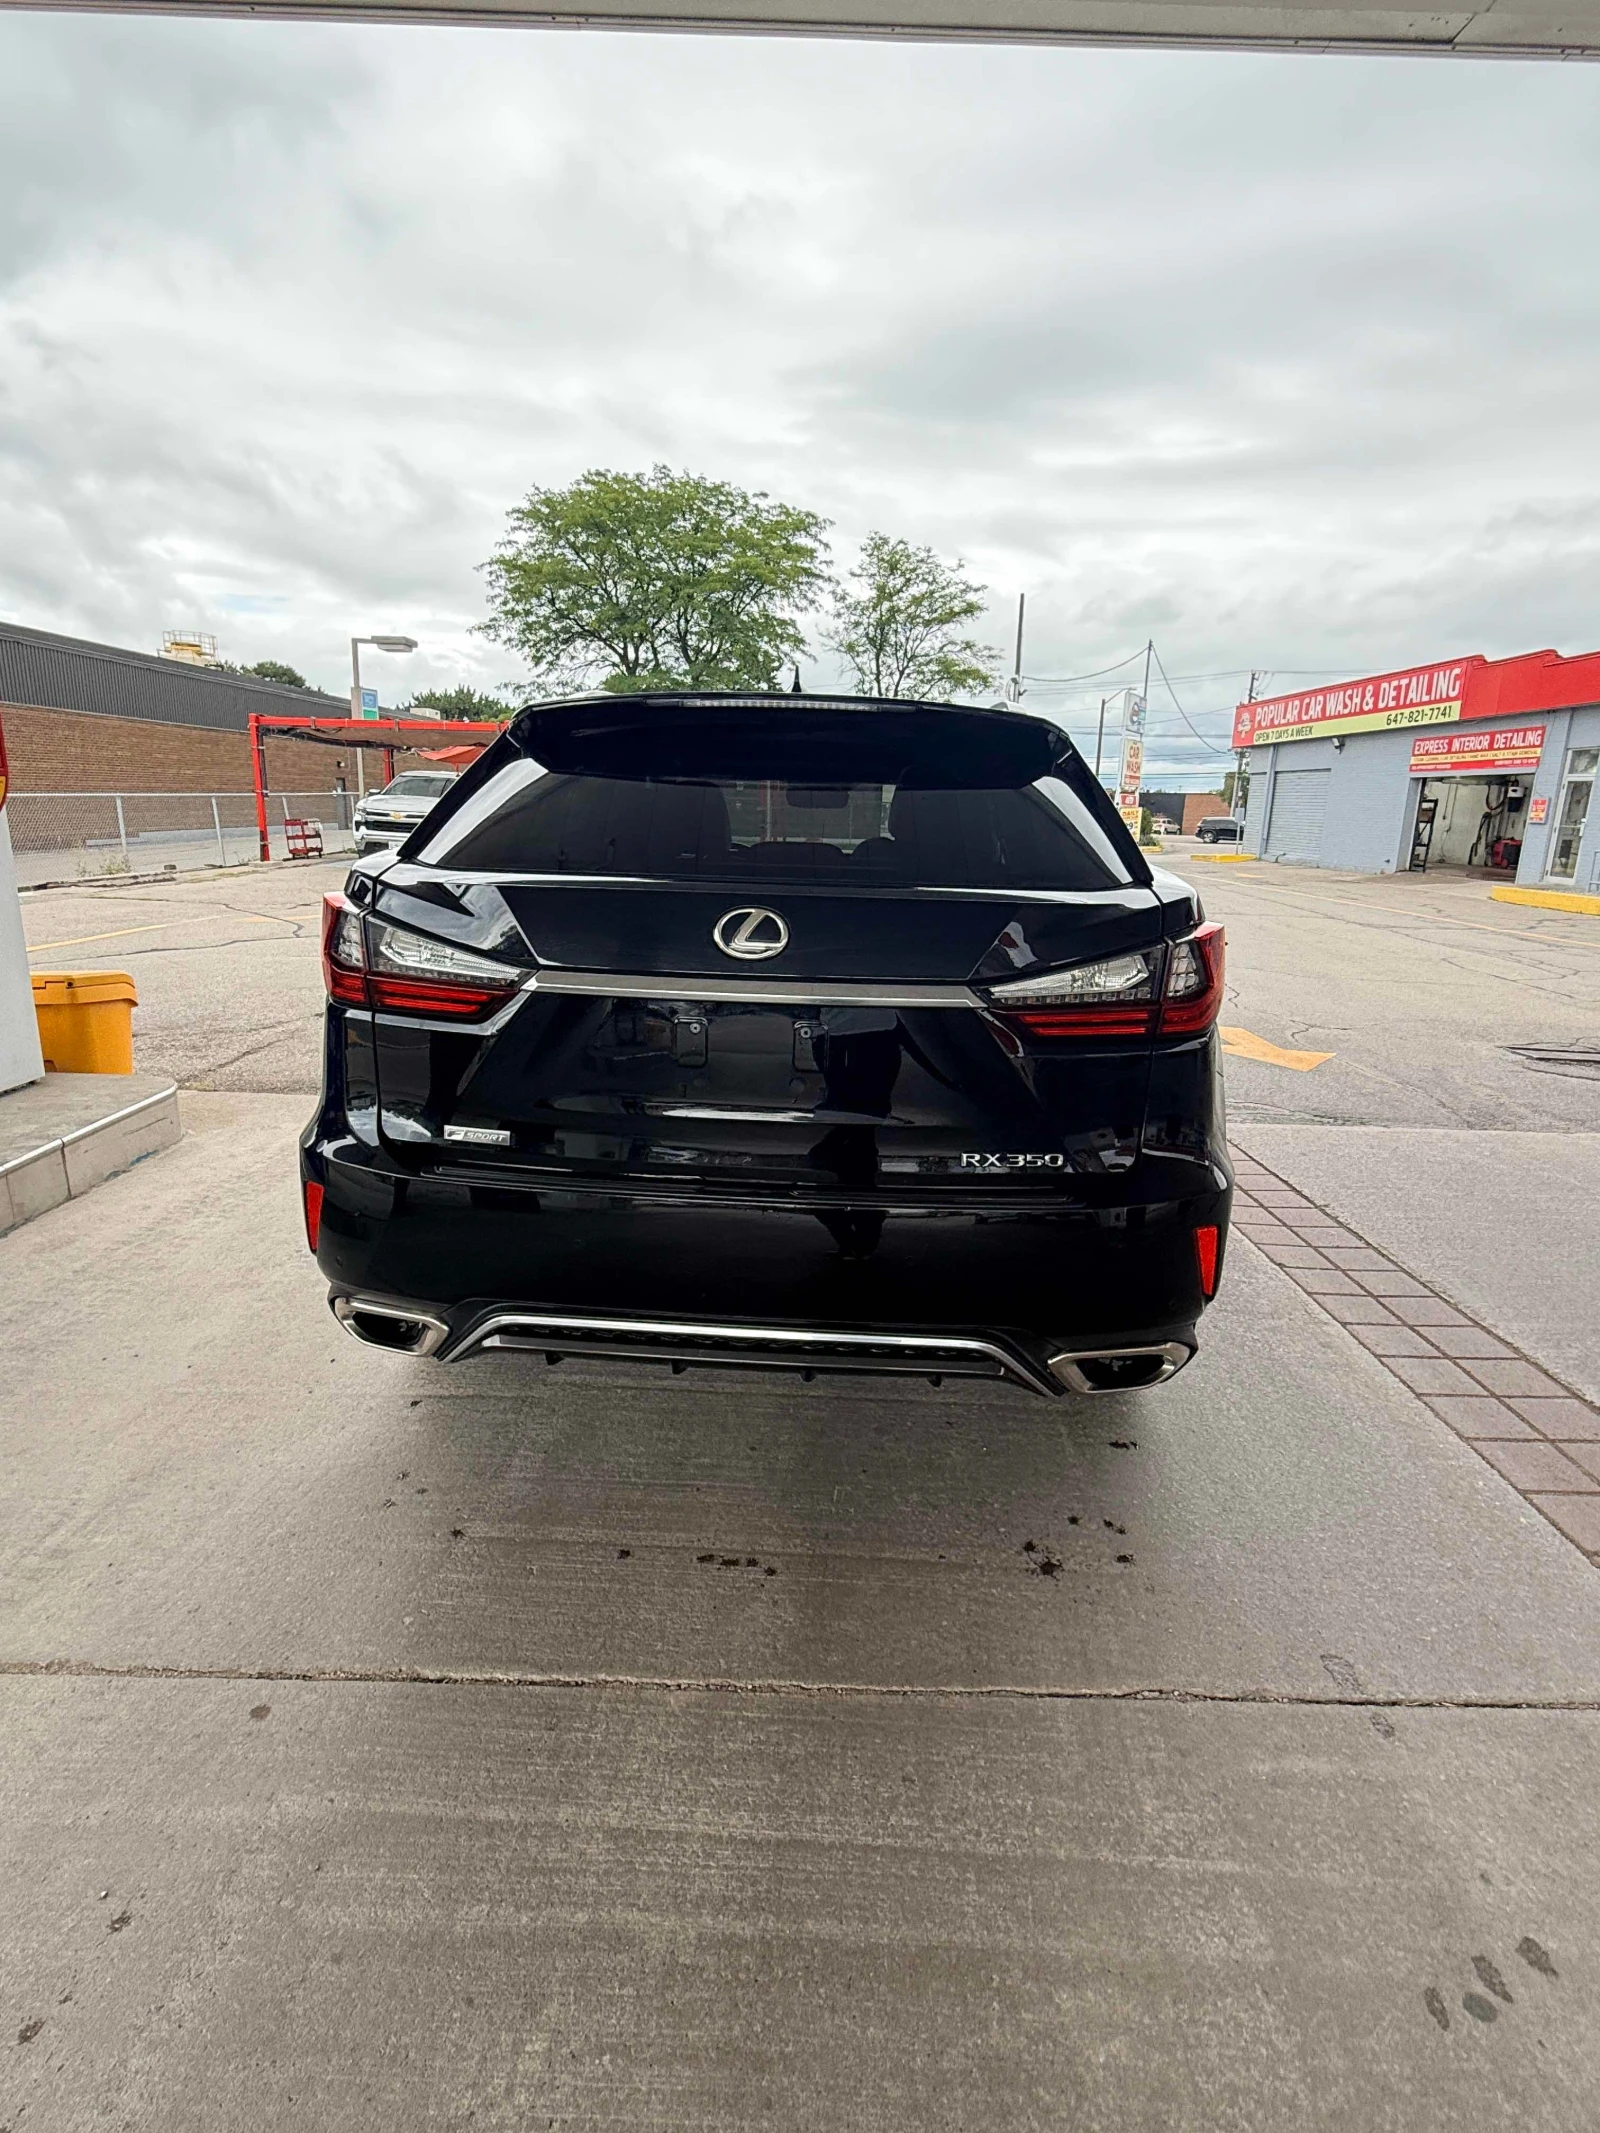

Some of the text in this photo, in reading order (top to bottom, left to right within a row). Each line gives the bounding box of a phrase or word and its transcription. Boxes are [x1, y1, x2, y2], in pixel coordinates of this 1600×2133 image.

[1255, 700, 1300, 728] POPULAR
[1302, 695, 1324, 720] CAR
[1326, 687, 1362, 717] WASH
[1363, 685, 1374, 711] &
[1378, 667, 1462, 709] DETAILING
[1386, 705, 1452, 726] 647-821-7741
[1255, 725, 1314, 742] OPEN 7 DAYS A WEEK
[1414, 730, 1542, 755] EXPRESS INTERIOR DETAILING
[1129, 745, 1140, 760] CAR
[1126, 760, 1141, 774] WASH
[466, 1131, 506, 1142] SPORT
[960, 1152, 1064, 1168] RX 350
